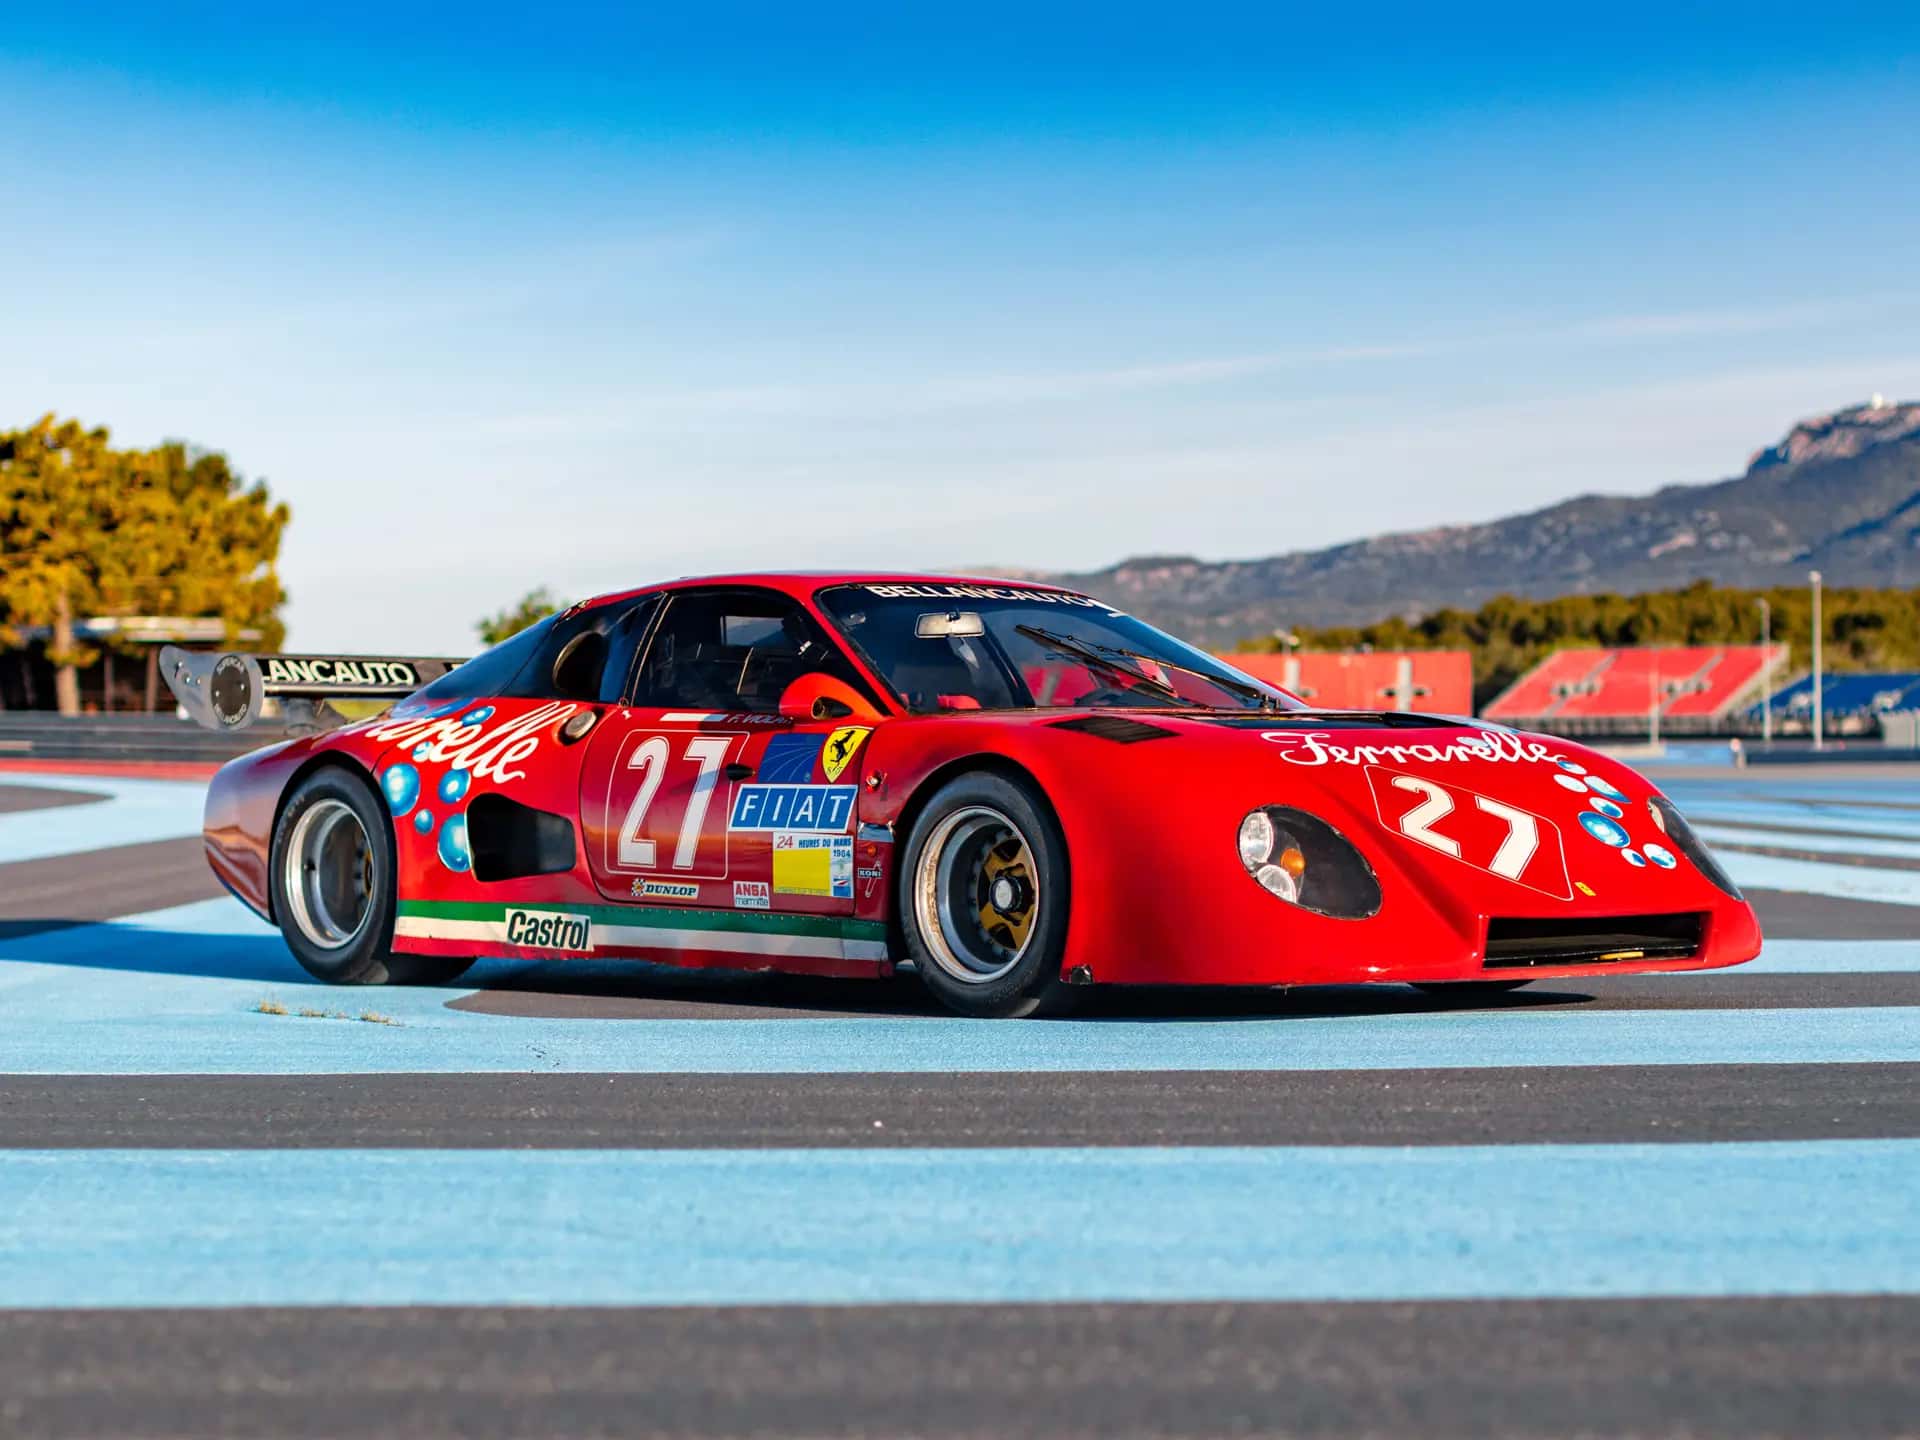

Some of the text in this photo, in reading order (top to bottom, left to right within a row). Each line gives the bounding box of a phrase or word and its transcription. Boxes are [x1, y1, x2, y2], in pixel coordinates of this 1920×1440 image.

[1260, 731, 1567, 766] Ferrarelle
[617, 735, 733, 870] 27
[740, 794, 849, 823] FIAT
[776, 835, 794, 849] 24
[798, 838, 820, 848] HEURES
[822, 838, 831, 848] DU
[1390, 775, 1540, 882] 27
[857, 868, 882, 879] KONI
[644, 883, 697, 897] DUNLOP
[735, 883, 767, 897] ANSA
[507, 911, 591, 950] Castrol
